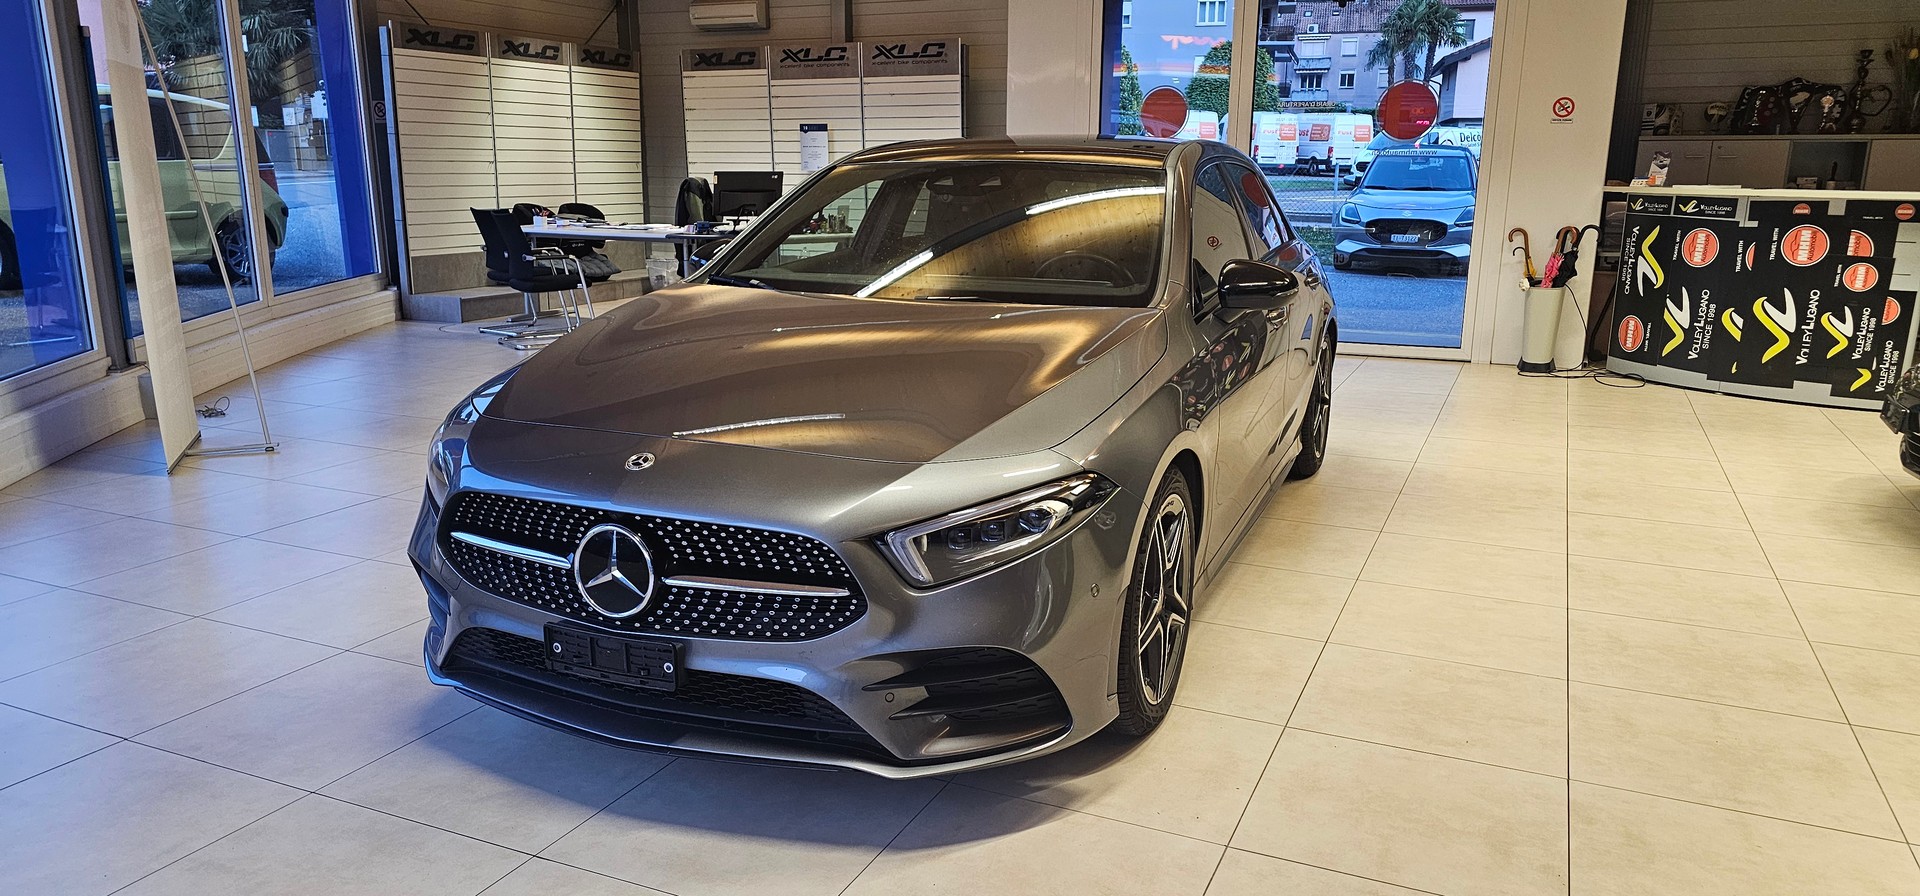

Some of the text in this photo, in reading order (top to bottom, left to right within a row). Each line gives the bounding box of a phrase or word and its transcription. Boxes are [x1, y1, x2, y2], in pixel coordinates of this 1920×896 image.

[405, 28, 475, 50] XLC
[502, 40, 560, 61] XLC
[580, 48, 632, 67] XLC
[694, 51, 756, 66] XLC
[779, 46, 847, 62] XLC
[871, 42, 945, 59] XLC
[1693, 233, 1705, 262] MHM
[1769, 241, 1778, 260] TRAVEL
[1797, 230, 1811, 261] MHM
[1855, 266, 1866, 288] MHM
[1702, 303, 1716, 350] SINCE 1998
[1864, 317, 1877, 351] SINCE 1998
[1888, 365, 1897, 384] SINCE
